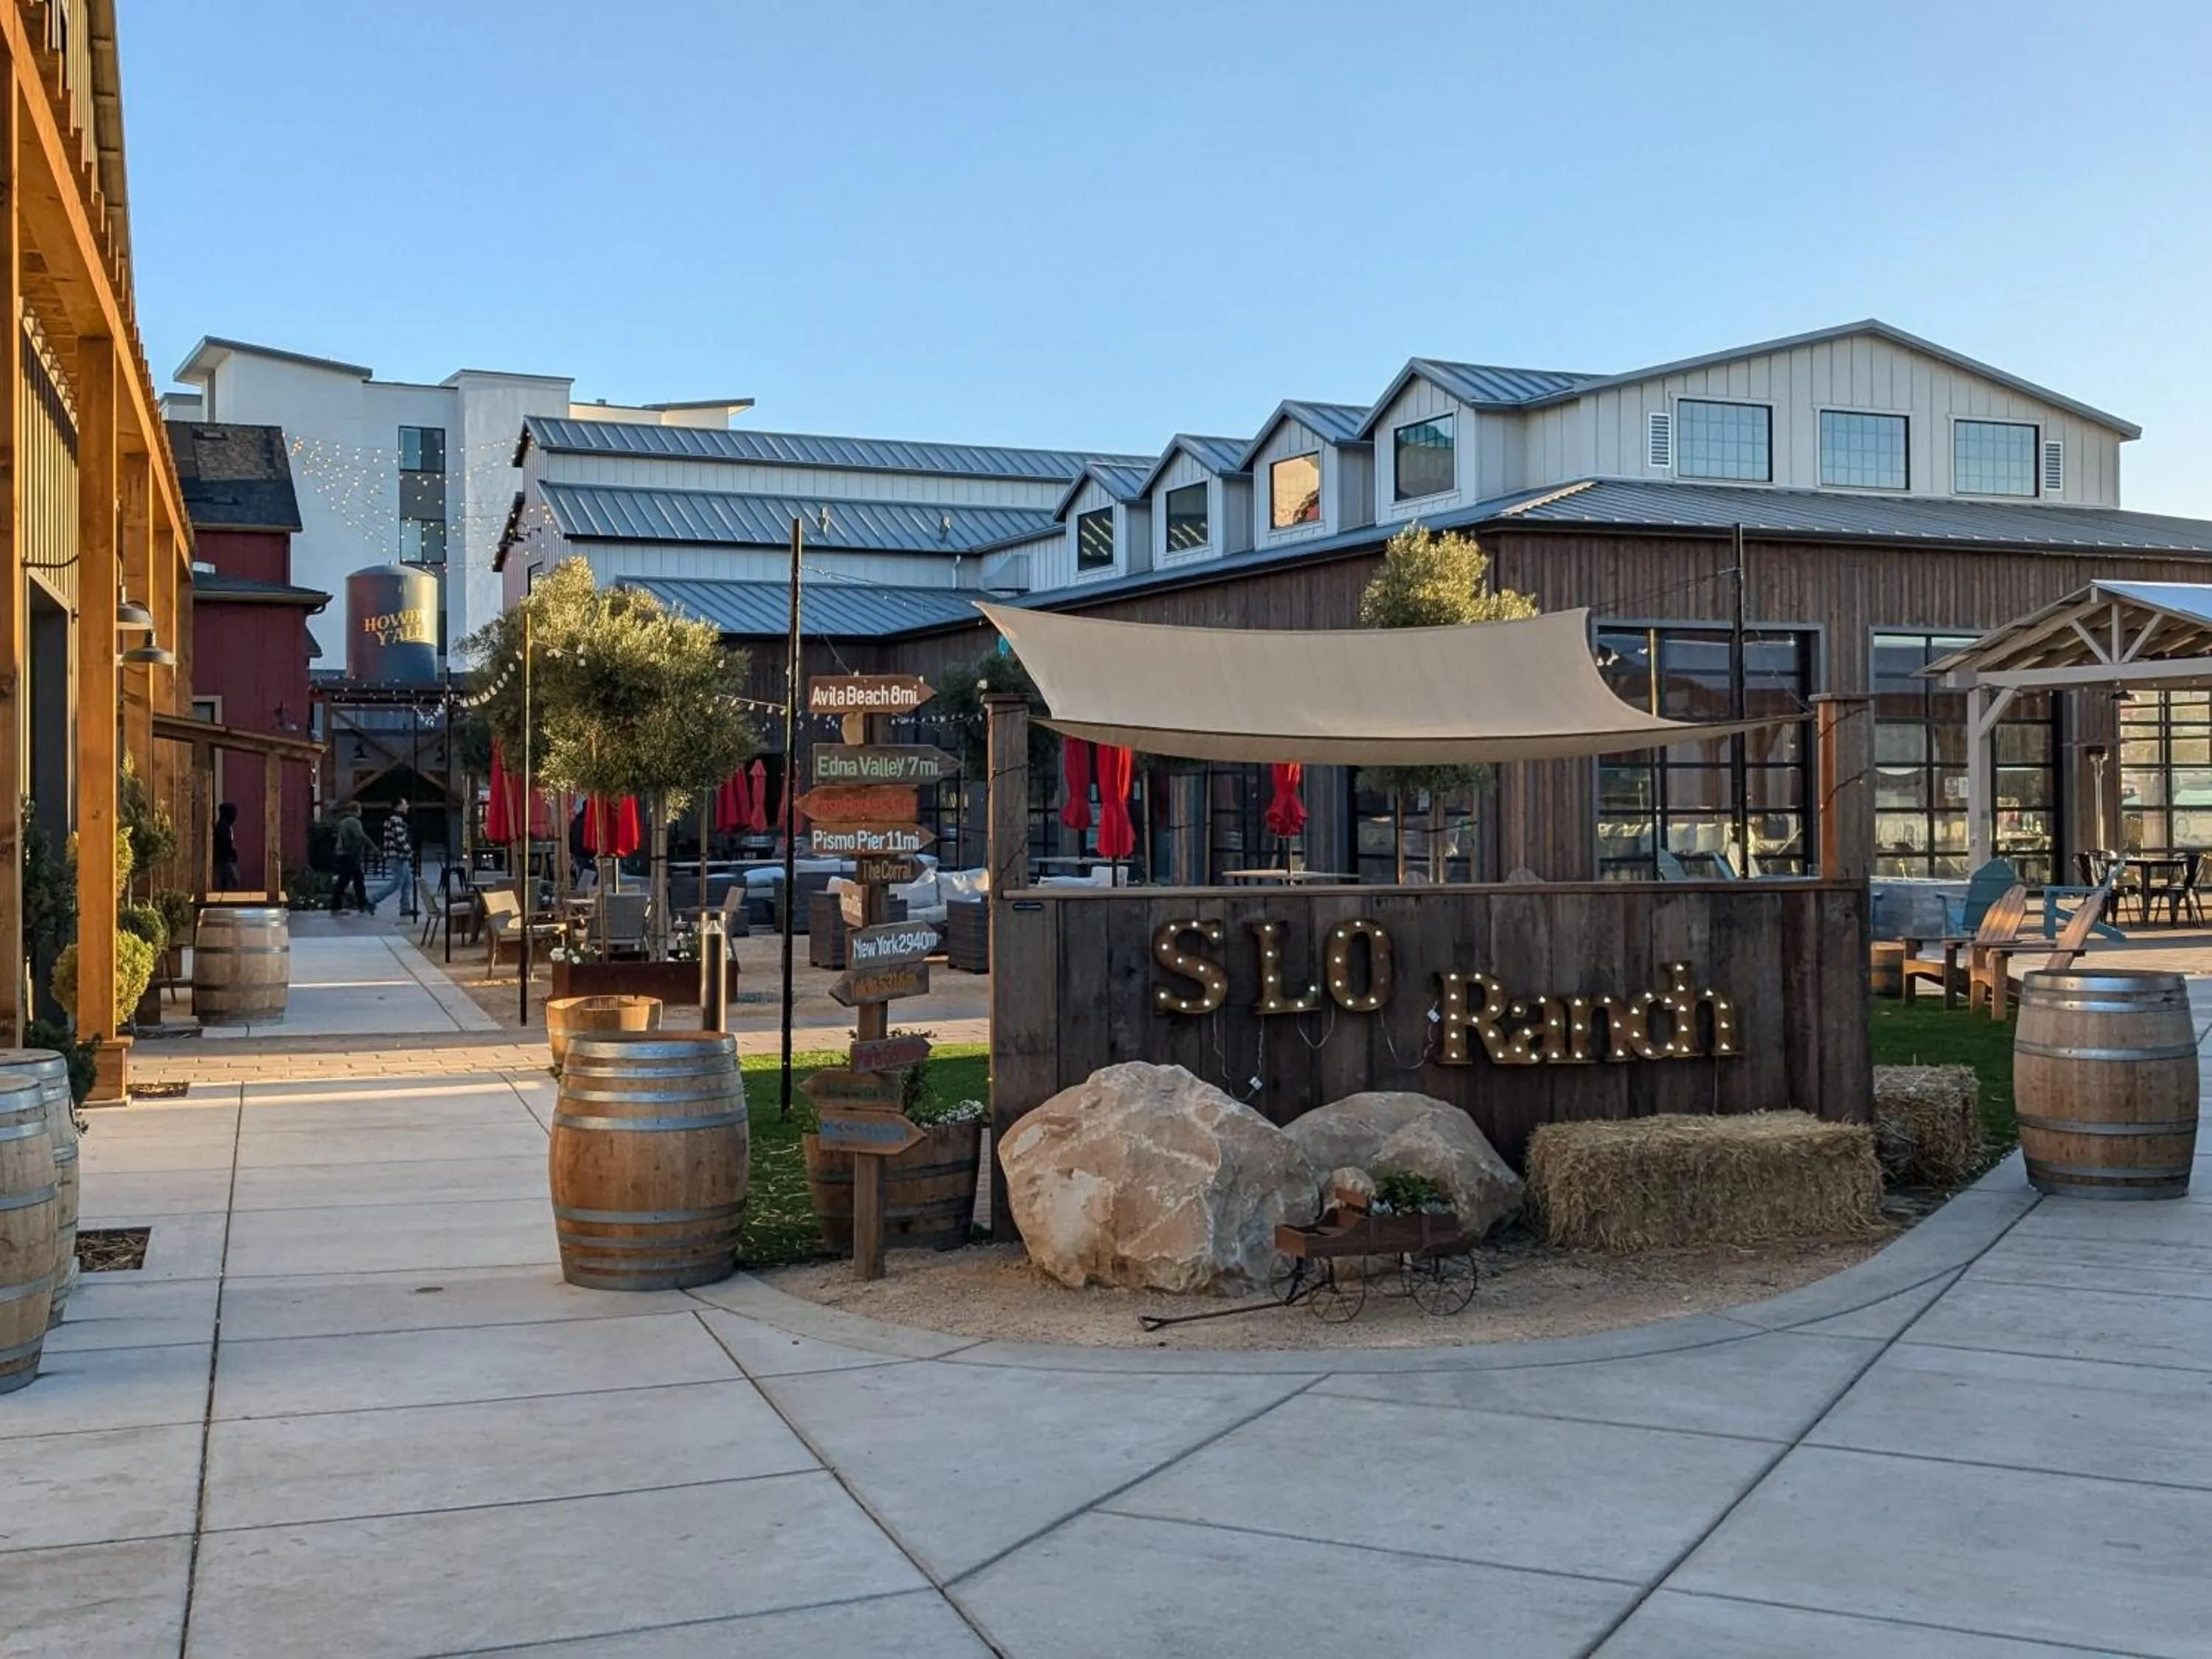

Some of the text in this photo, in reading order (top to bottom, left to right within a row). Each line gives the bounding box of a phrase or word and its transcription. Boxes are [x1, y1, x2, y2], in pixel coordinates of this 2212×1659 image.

[364, 609, 425, 633] HOWD
[375, 625, 424, 647] Y'ALL
[812, 686, 847, 706] Avila
[847, 685, 889, 706] Beach
[817, 756, 858, 776] Edna
[858, 756, 905, 778] Valley
[813, 830, 855, 849] Pismo
[857, 830, 885, 849] Pier
[861, 860, 912, 880] The Corral
[852, 938, 876, 959] New
[875, 932, 900, 956] York
[1153, 919, 1743, 1065] SLO Ranch
